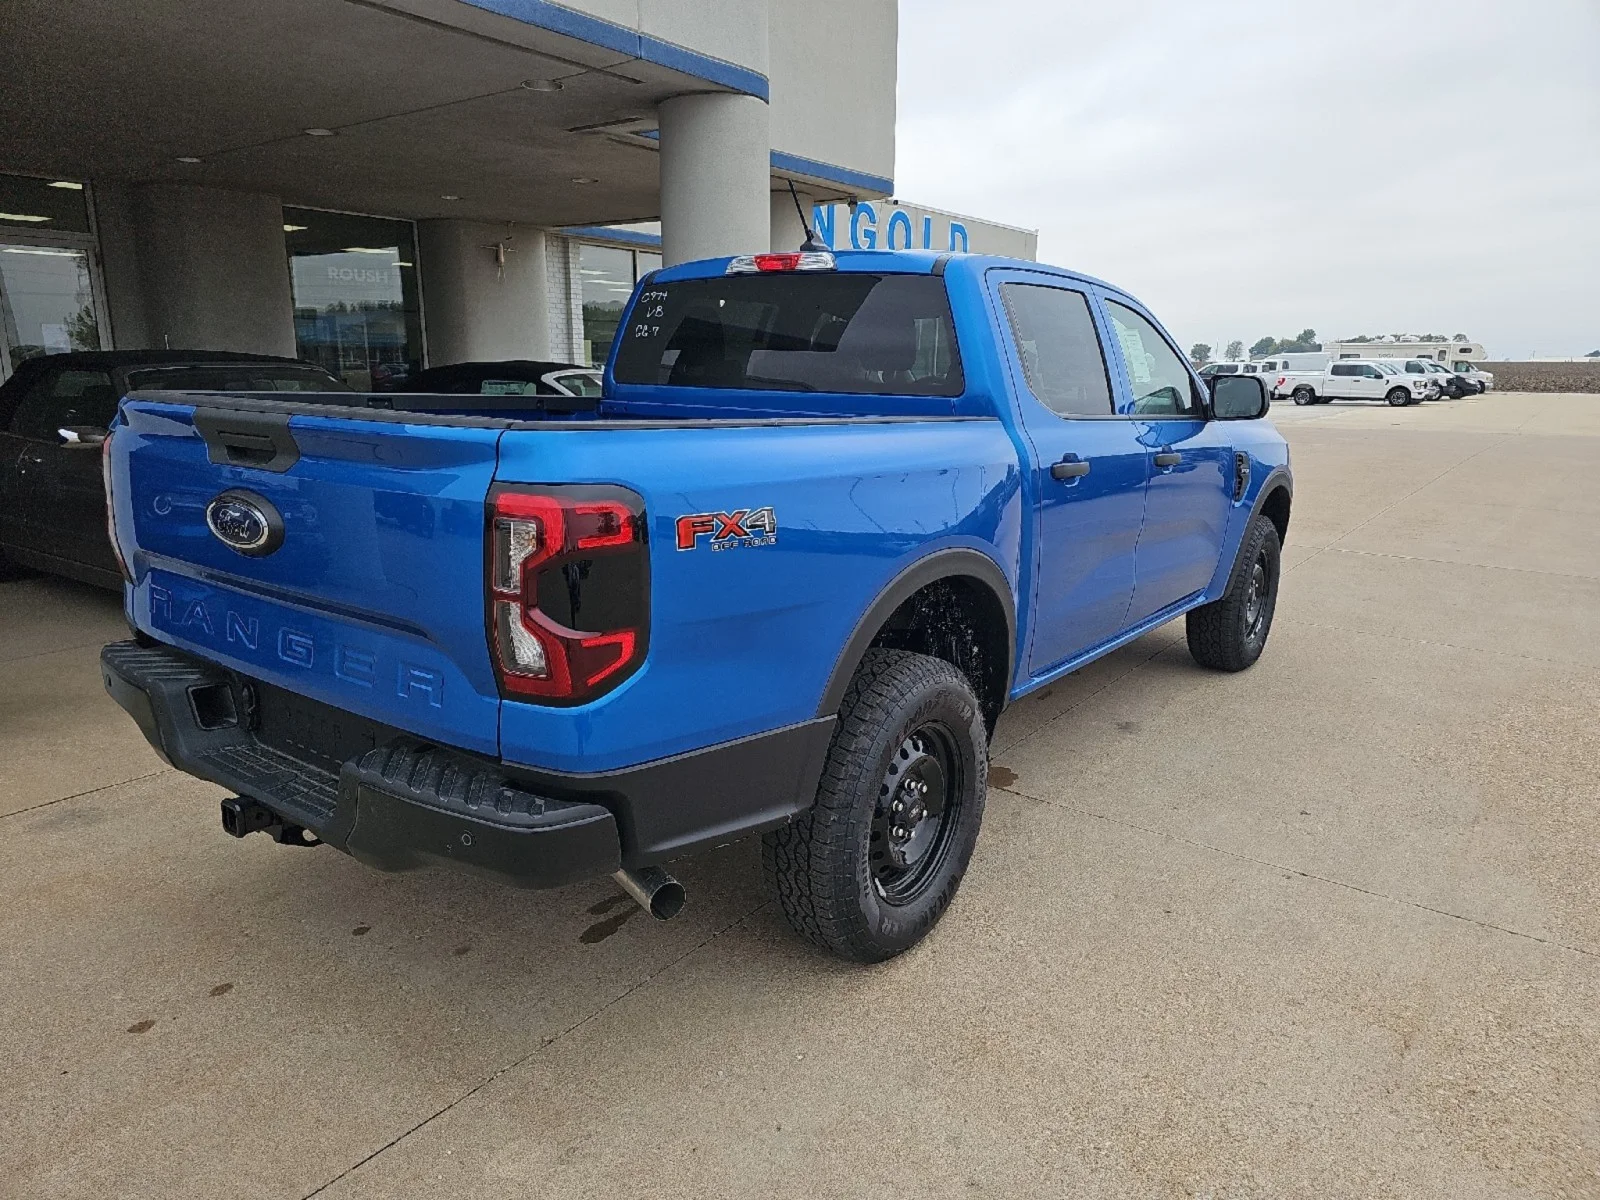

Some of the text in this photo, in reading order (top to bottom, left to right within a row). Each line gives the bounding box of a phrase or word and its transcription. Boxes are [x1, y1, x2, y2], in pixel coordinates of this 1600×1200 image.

[329, 267, 388, 283] ROUSH
[216, 507, 250, 540] Ford
[676, 507, 777, 551] FX4
[711, 536, 777, 552] OFF ROAD
[149, 583, 445, 709] RANGER
